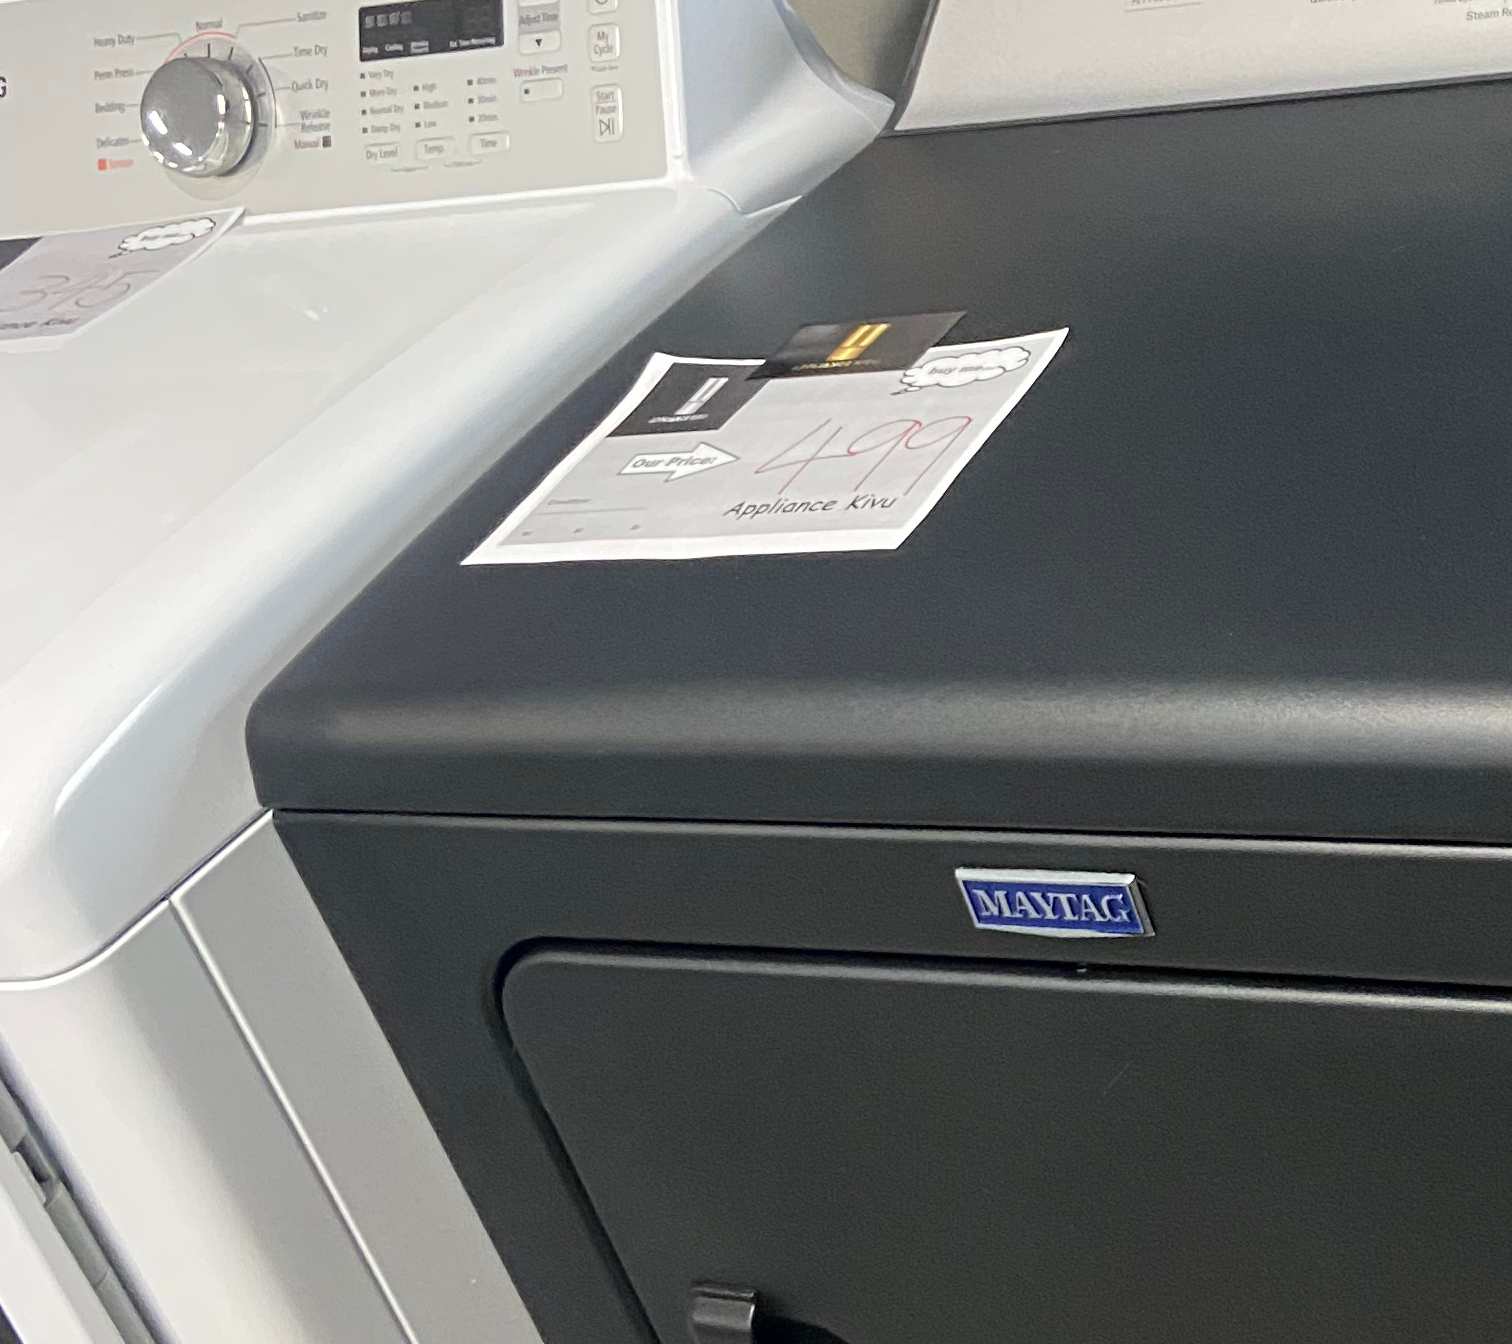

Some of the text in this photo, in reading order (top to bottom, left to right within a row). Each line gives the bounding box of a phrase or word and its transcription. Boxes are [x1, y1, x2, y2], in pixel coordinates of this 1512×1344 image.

[519, 14, 541, 27] Adjust
[1466, 10, 1499, 22] Steam
[293, 44, 328, 57] Time Dry
[291, 78, 329, 92] Quick Dry
[596, 91, 615, 102] Start
[366, 150, 378, 161] Dry
[754, 415, 973, 497] 499
[632, 457, 662, 469] Our
[722, 493, 898, 519] Appliance Kivu
[972, 888, 1132, 923] MAYTAG
